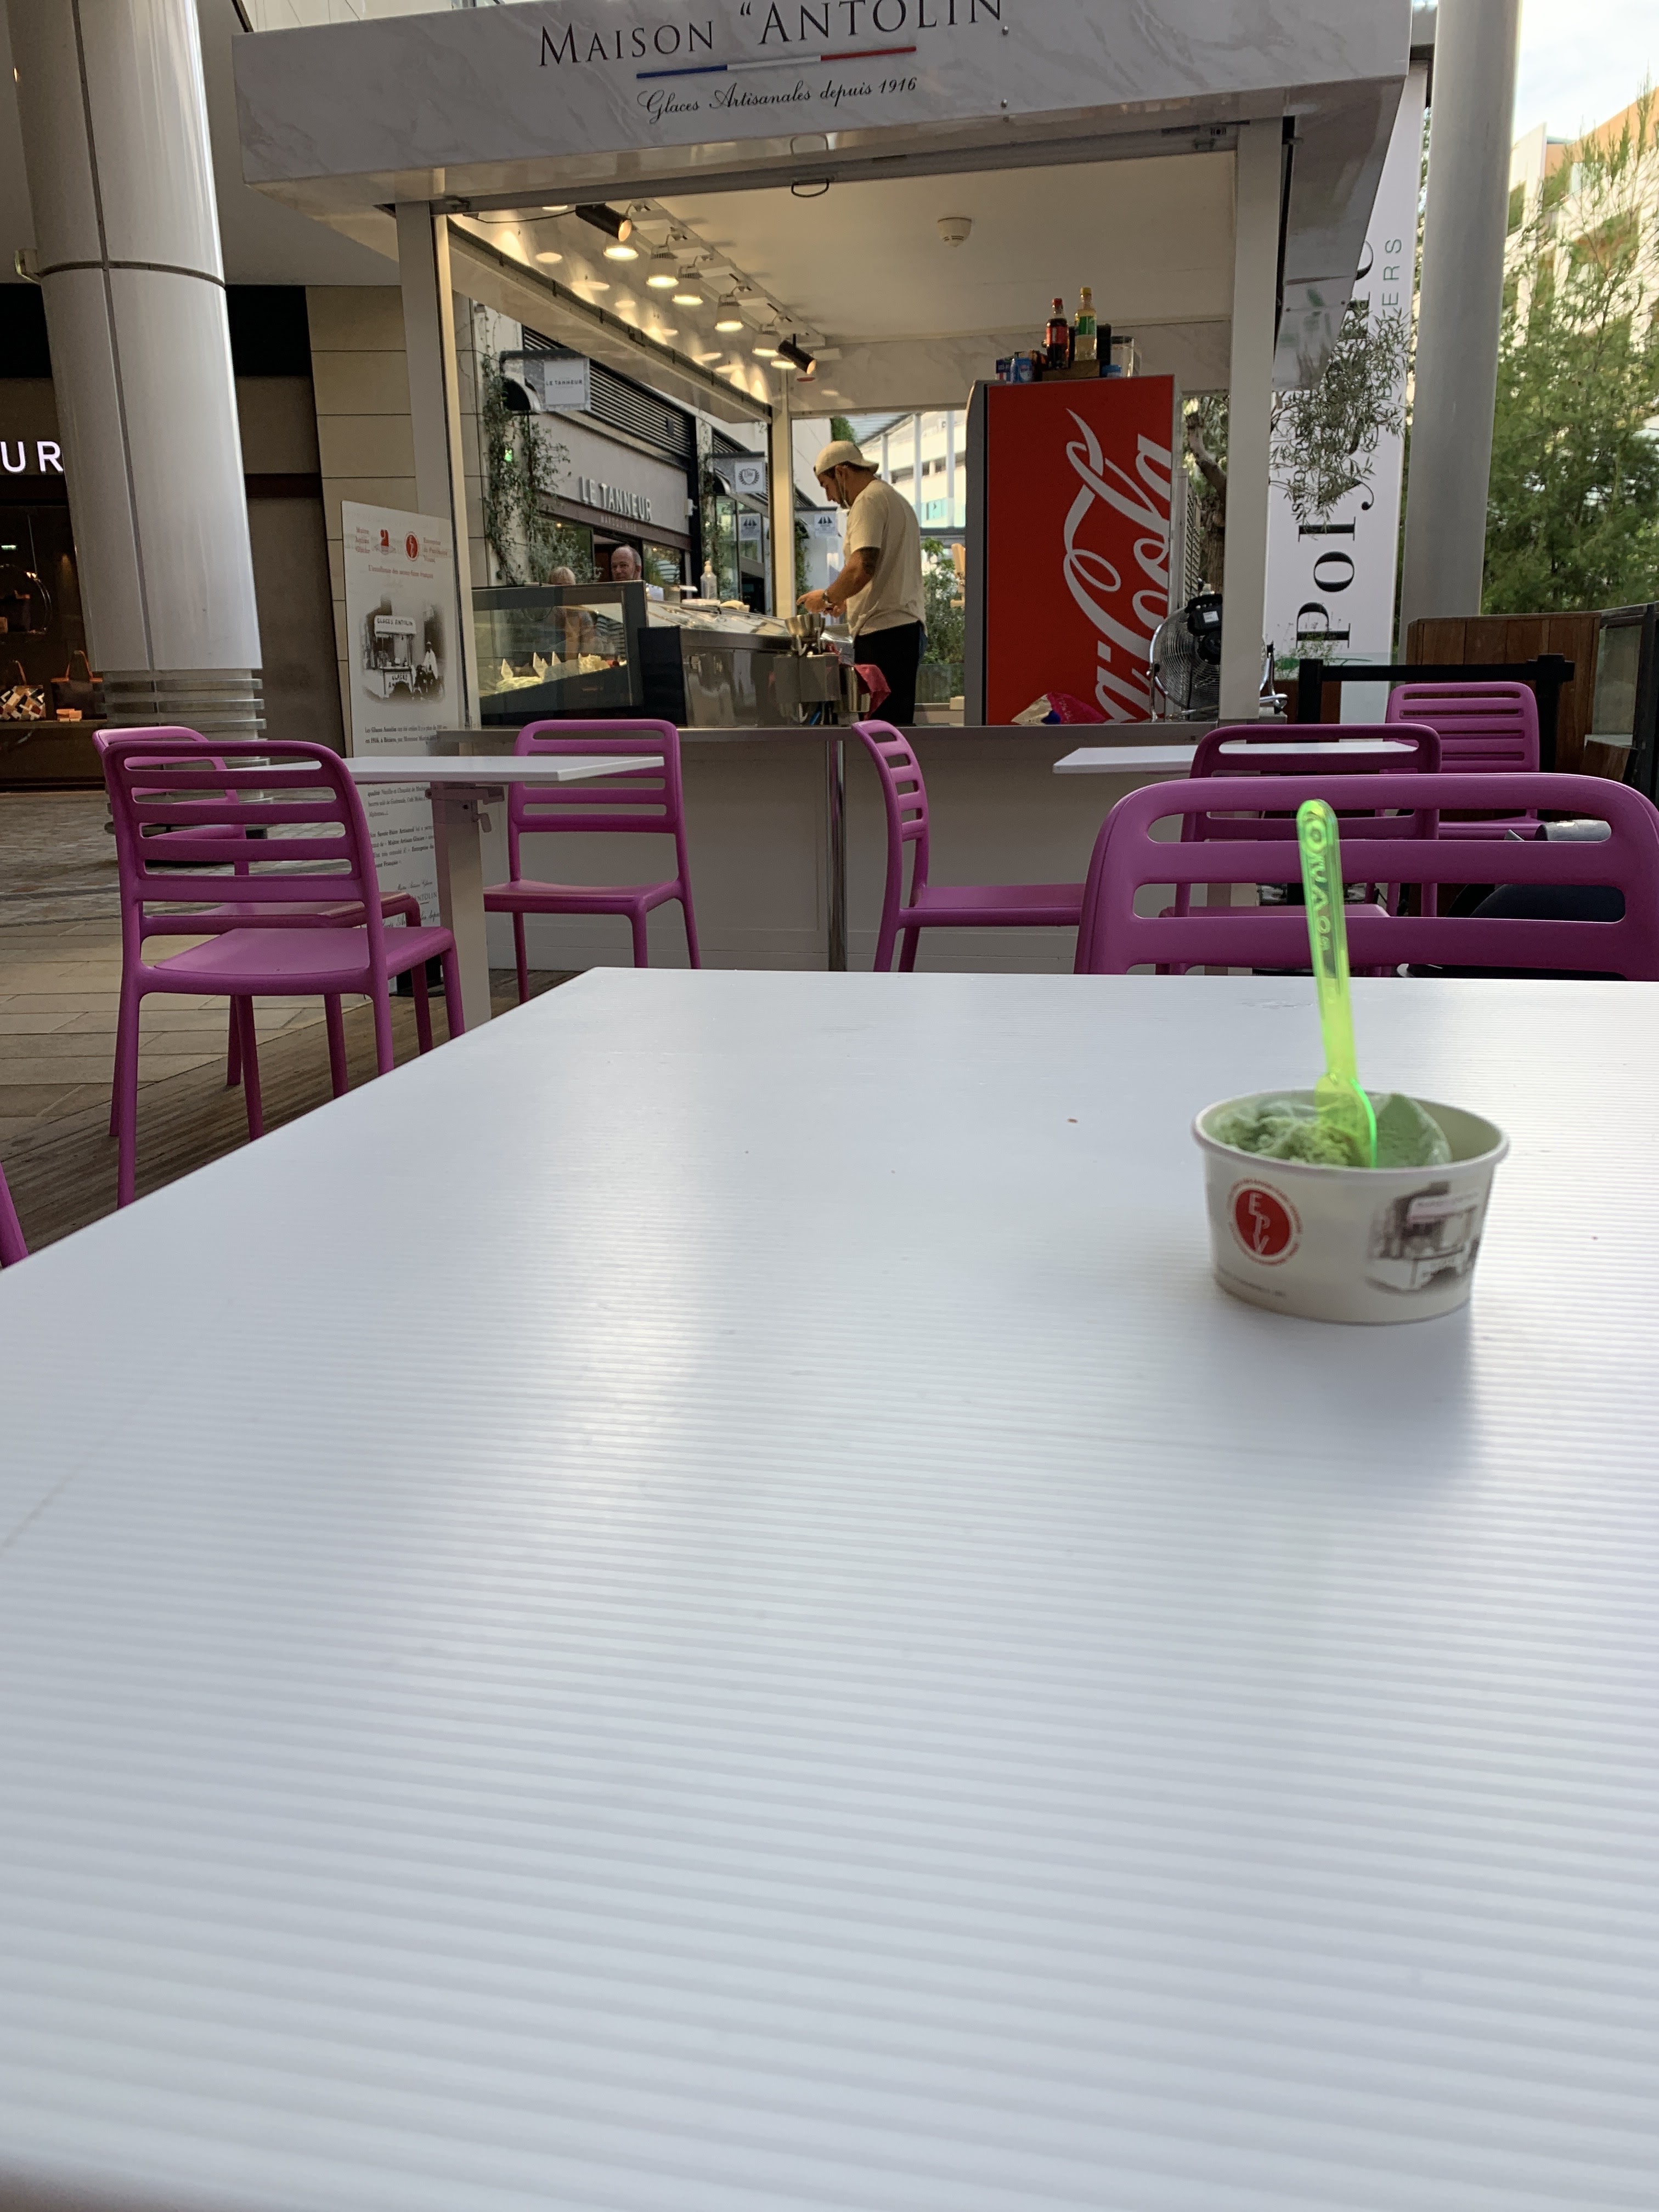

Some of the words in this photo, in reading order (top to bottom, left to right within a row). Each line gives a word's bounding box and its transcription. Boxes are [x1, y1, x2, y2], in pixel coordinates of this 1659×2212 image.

[539, 20, 713, 66] MAISON
[637, 89, 699, 124] Glaces
[709, 80, 811, 109] Artisanales
[820, 80, 873, 107] depuis
[879, 77, 917, 93] 1916
[579, 476, 597, 505] LE
[599, 483, 652, 522] TANNEUR
